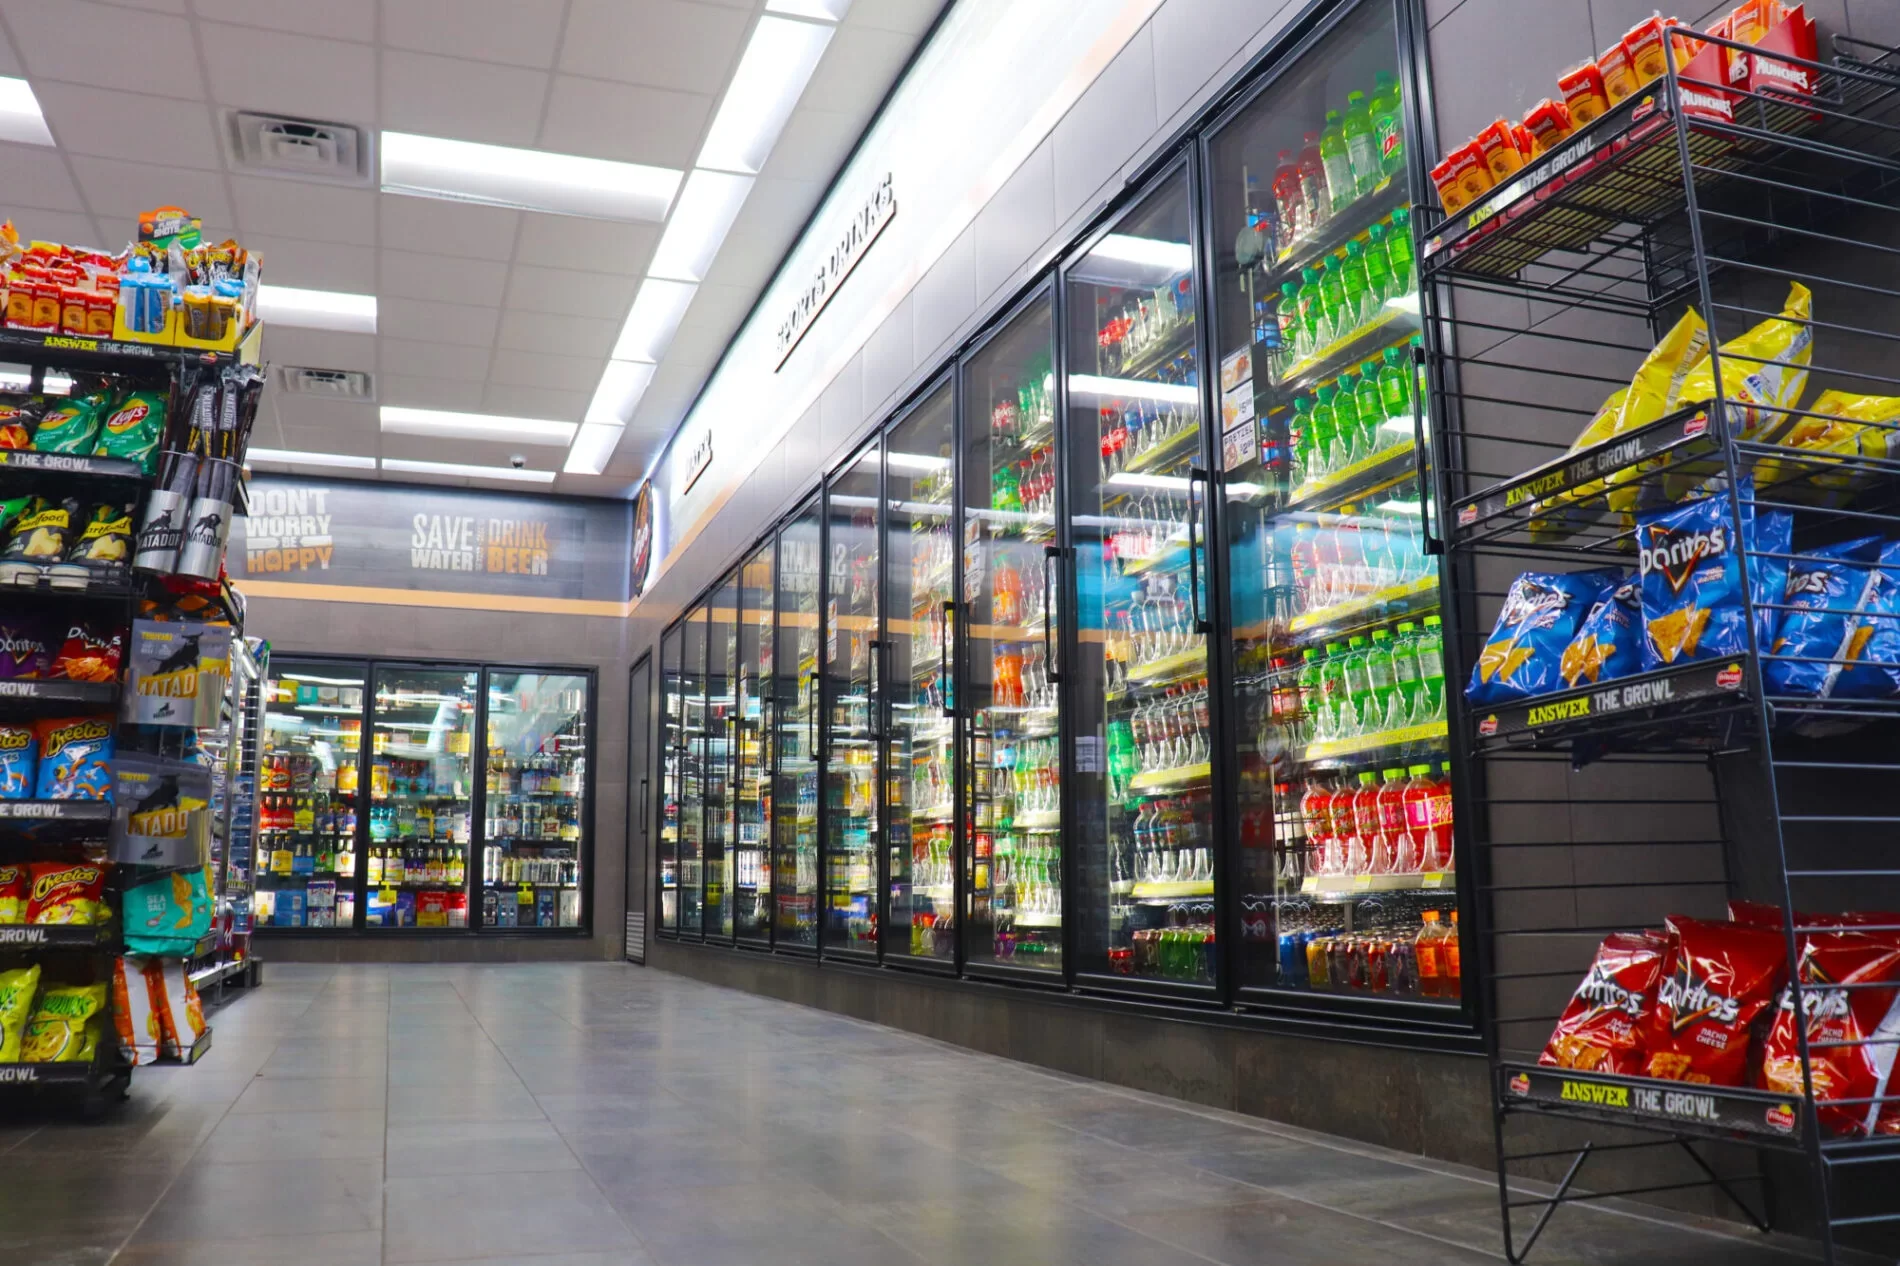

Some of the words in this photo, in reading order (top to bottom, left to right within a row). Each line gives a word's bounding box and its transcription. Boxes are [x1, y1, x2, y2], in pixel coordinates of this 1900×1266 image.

[1526, 169, 1550, 191] THE
[1552, 135, 1597, 174] GROWL
[44, 336, 98, 351] ANSWER
[102, 342, 120, 353] THE
[1224, 425, 1254, 447] PRETZEL
[13, 452, 40, 467] THE
[44, 455, 94, 471] GROWL
[1505, 470, 1565, 507] ANSWER
[1569, 459, 1594, 481] THE
[1597, 438, 1646, 471] GROWL
[247, 488, 331, 517] DON'T
[245, 514, 332, 538] WORRY
[411, 512, 475, 551] SAVE
[488, 518, 548, 549] DRINK
[247, 546, 332, 573] HOPPY
[411, 547, 474, 572] WATER
[487, 546, 548, 575] BEER
[1641, 526, 1724, 576] Doritos
[0, 682, 39, 696] ROWL
[1526, 697, 1590, 726] ANSWER
[1593, 691, 1620, 711] THE
[1623, 679, 1675, 706] GROWL
[13, 803, 64, 816] GROWL
[35, 867, 97, 900] Cheetos
[147, 895, 166, 905] SEA
[1659, 975, 1739, 1022] Doritos
[1696, 1034, 1727, 1050] CHEESE
[1701, 1027, 1728, 1041] NACHO
[1561, 1080, 1630, 1107] ANSWER
[1633, 1087, 1661, 1112] THE
[1665, 1091, 1720, 1120] GROWL
